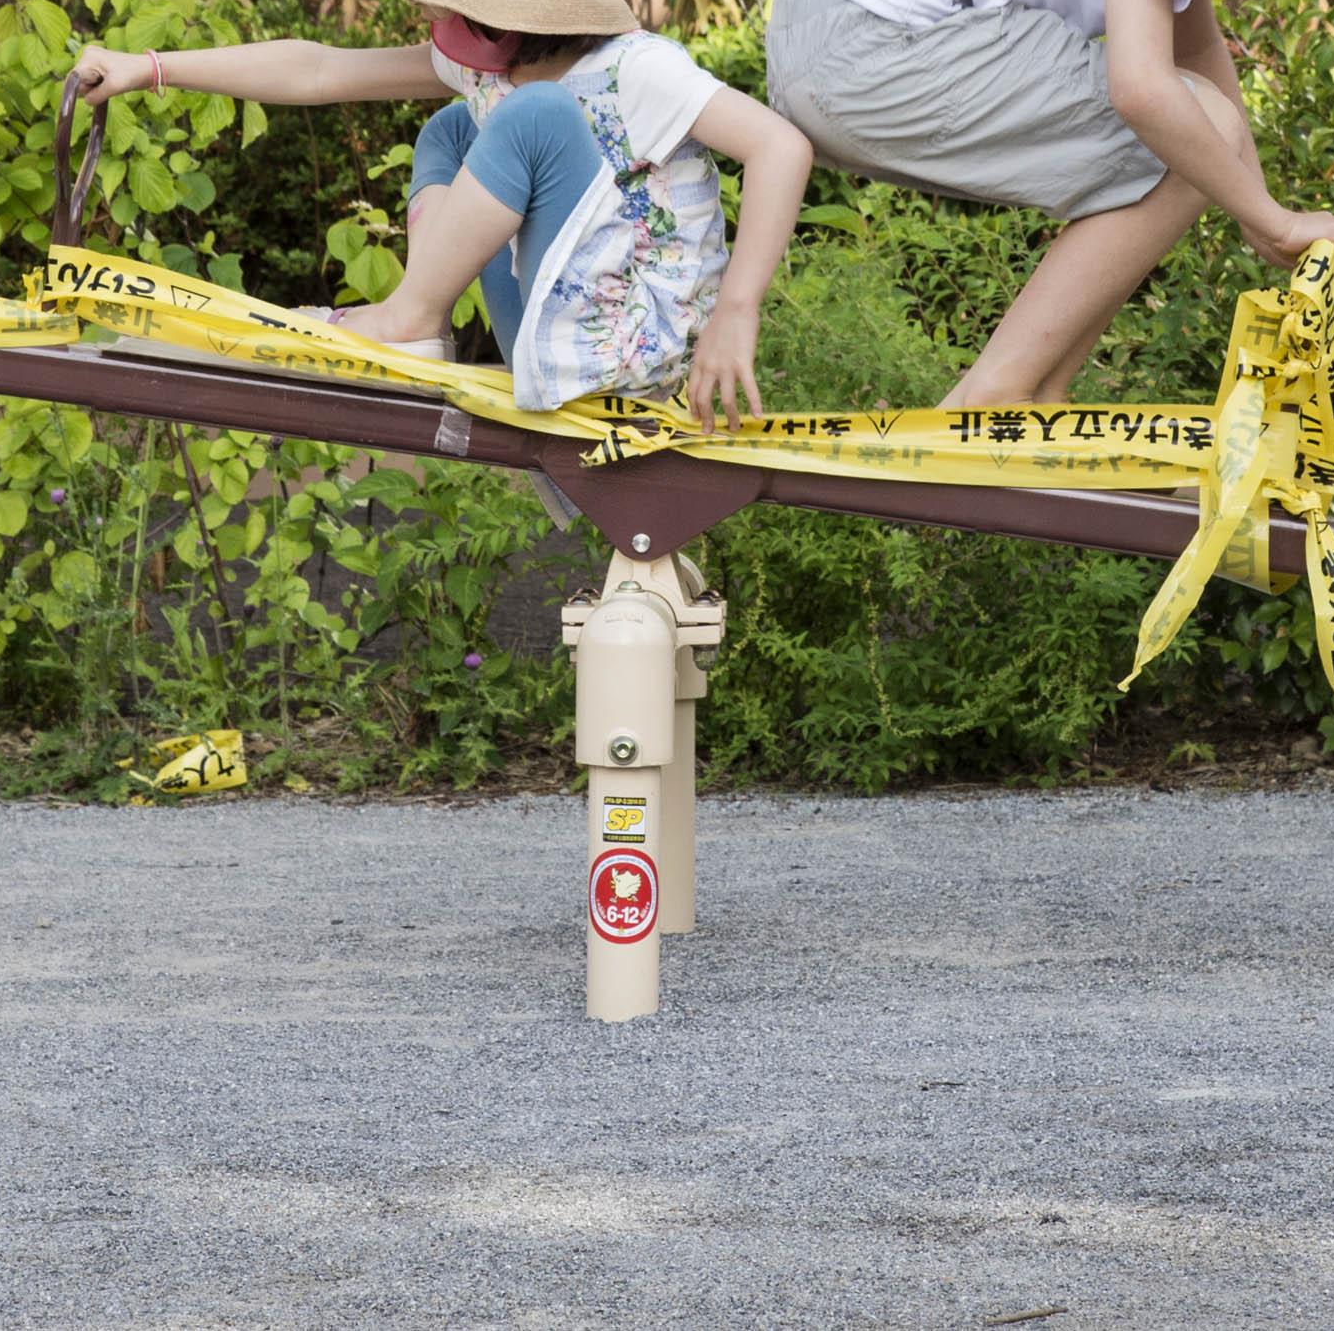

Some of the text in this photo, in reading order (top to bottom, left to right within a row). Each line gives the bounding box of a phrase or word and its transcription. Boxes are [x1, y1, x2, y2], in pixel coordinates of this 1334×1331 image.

[947, 409, 1215, 451] きけん立入禁止
[606, 807, 643, 831] SP
[606, 905, 640, 924] 6-12
